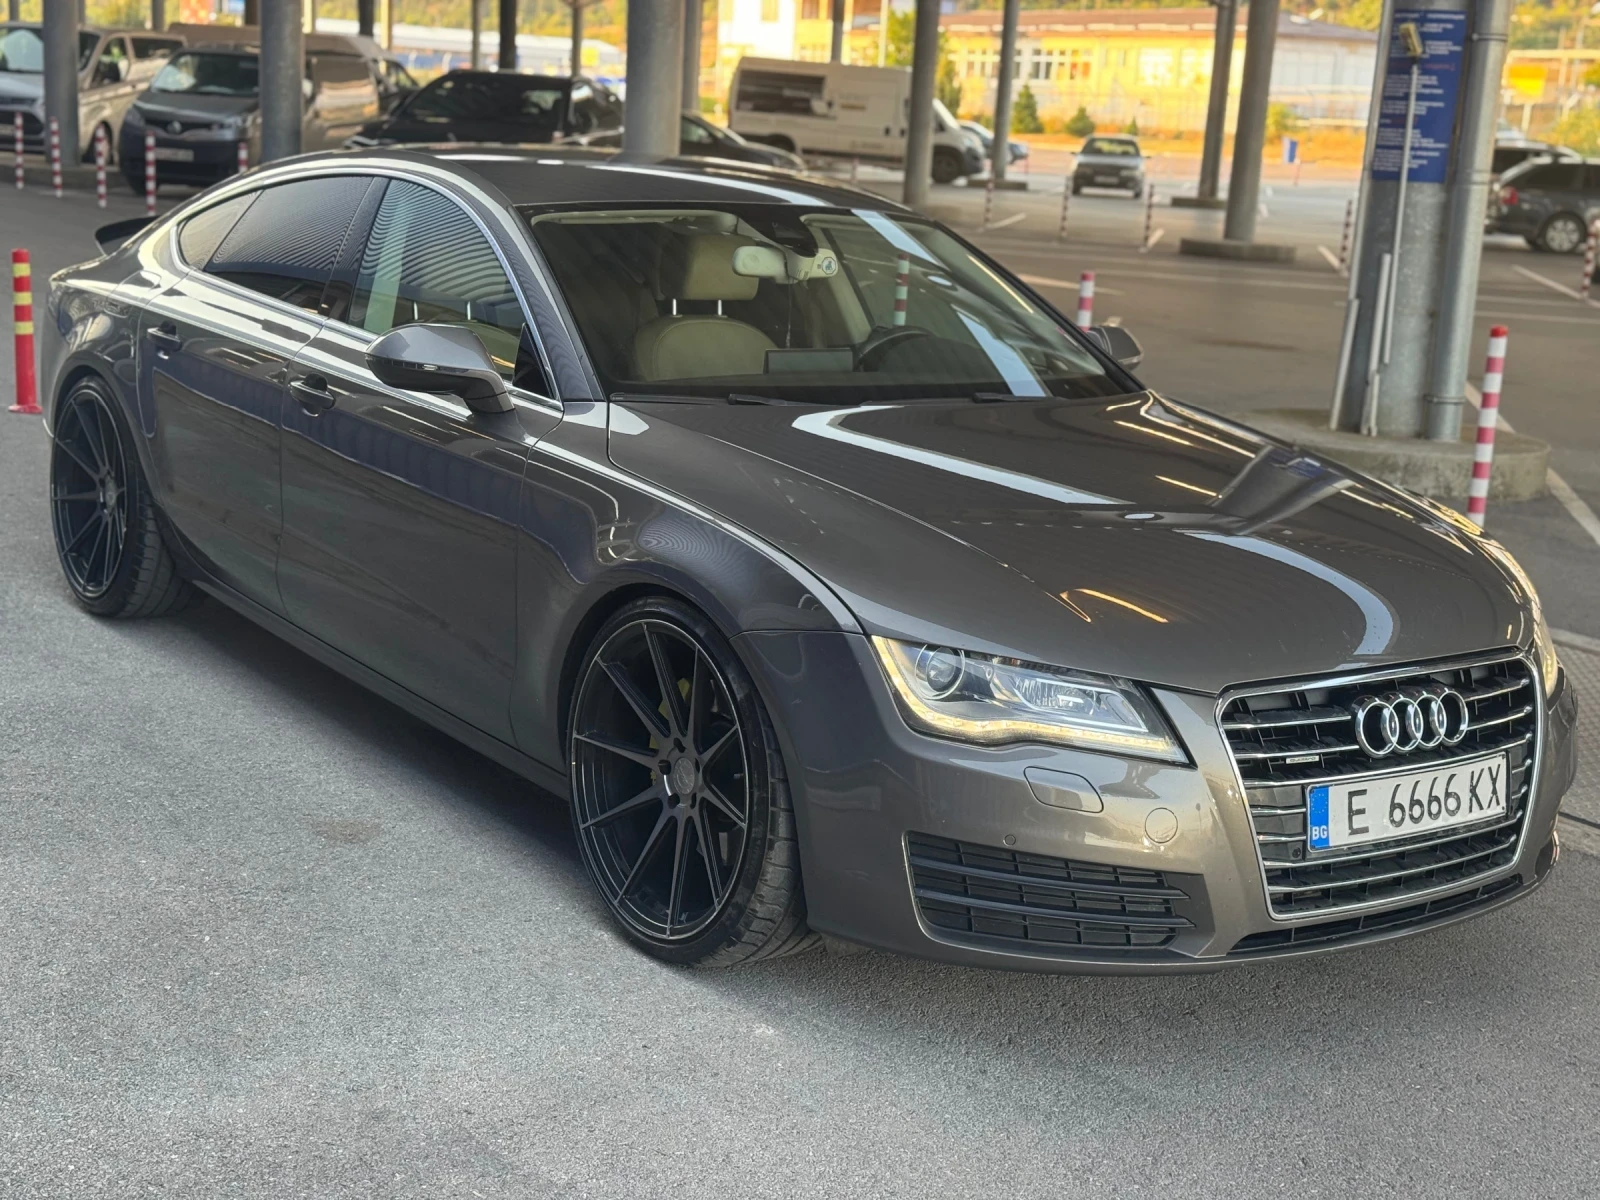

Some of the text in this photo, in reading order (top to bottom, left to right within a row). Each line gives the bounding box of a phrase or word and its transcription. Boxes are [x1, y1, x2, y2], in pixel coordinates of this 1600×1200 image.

[1348, 764, 1500, 836] E 6666 KX
[1312, 825, 1328, 840] BG
